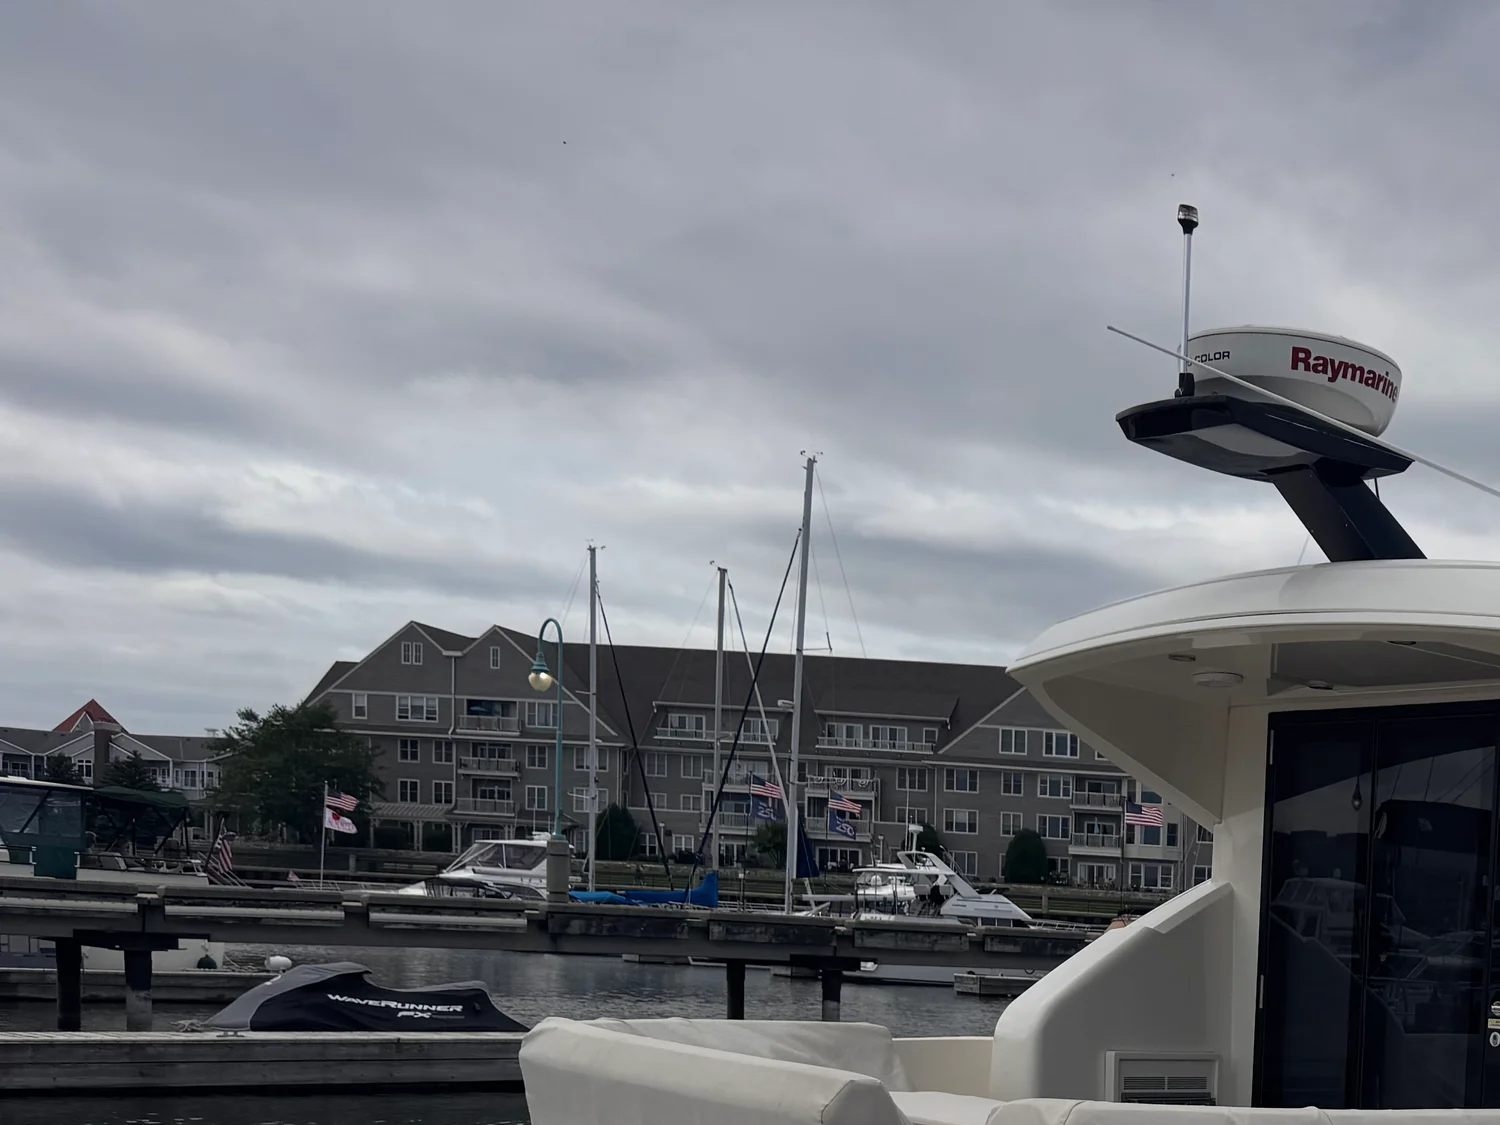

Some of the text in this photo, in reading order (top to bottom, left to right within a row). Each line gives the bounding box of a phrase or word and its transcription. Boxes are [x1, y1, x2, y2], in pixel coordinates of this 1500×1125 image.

[1194, 350, 1231, 363] COLOR
[1290, 346, 1398, 403] Raymarine
[397, 1011, 432, 1019] FX
